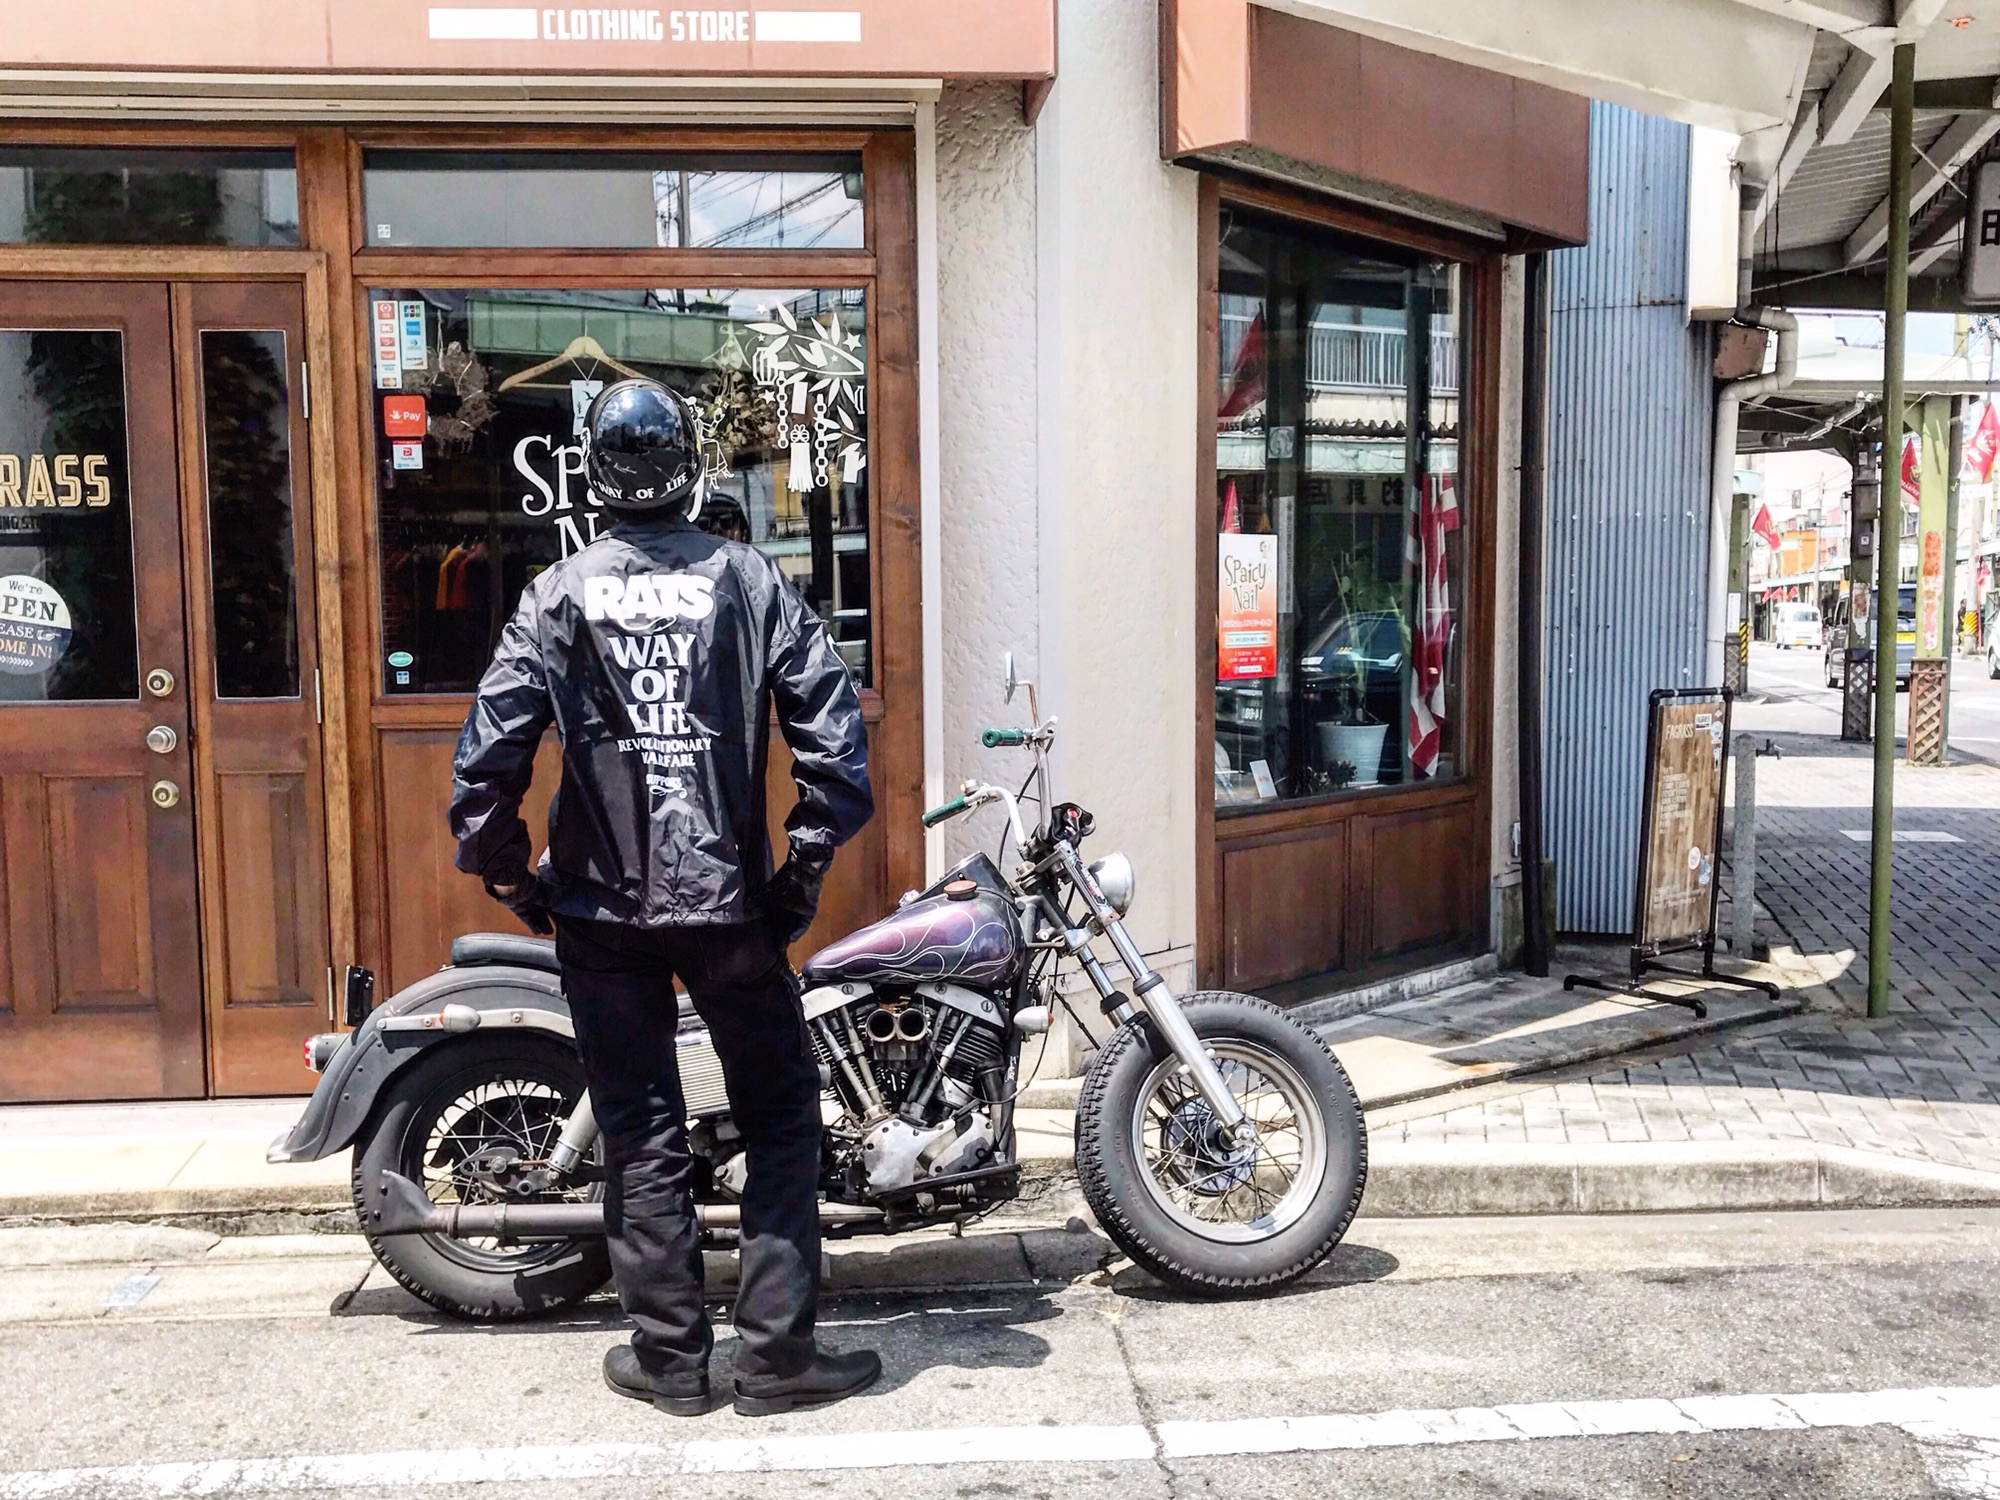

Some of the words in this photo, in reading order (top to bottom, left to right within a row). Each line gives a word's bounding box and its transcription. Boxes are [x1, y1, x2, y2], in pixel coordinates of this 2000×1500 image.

[543, 9, 663, 41] CLOTHING
[670, 11, 750, 42] STORE
[403, 411, 422, 422] Pay
[635, 487, 655, 499] OF
[665, 471, 689, 492] LIFE
[9, 580, 43, 595] We're
[584, 574, 715, 622] RATS
[1232, 584, 1259, 614] Nail
[31, 643, 53, 660] IN!
[607, 633, 697, 670] WAY
[630, 668, 680, 703] OF
[626, 701, 692, 736] LIFE
[617, 737, 712, 754] REVOLUTIONARY
